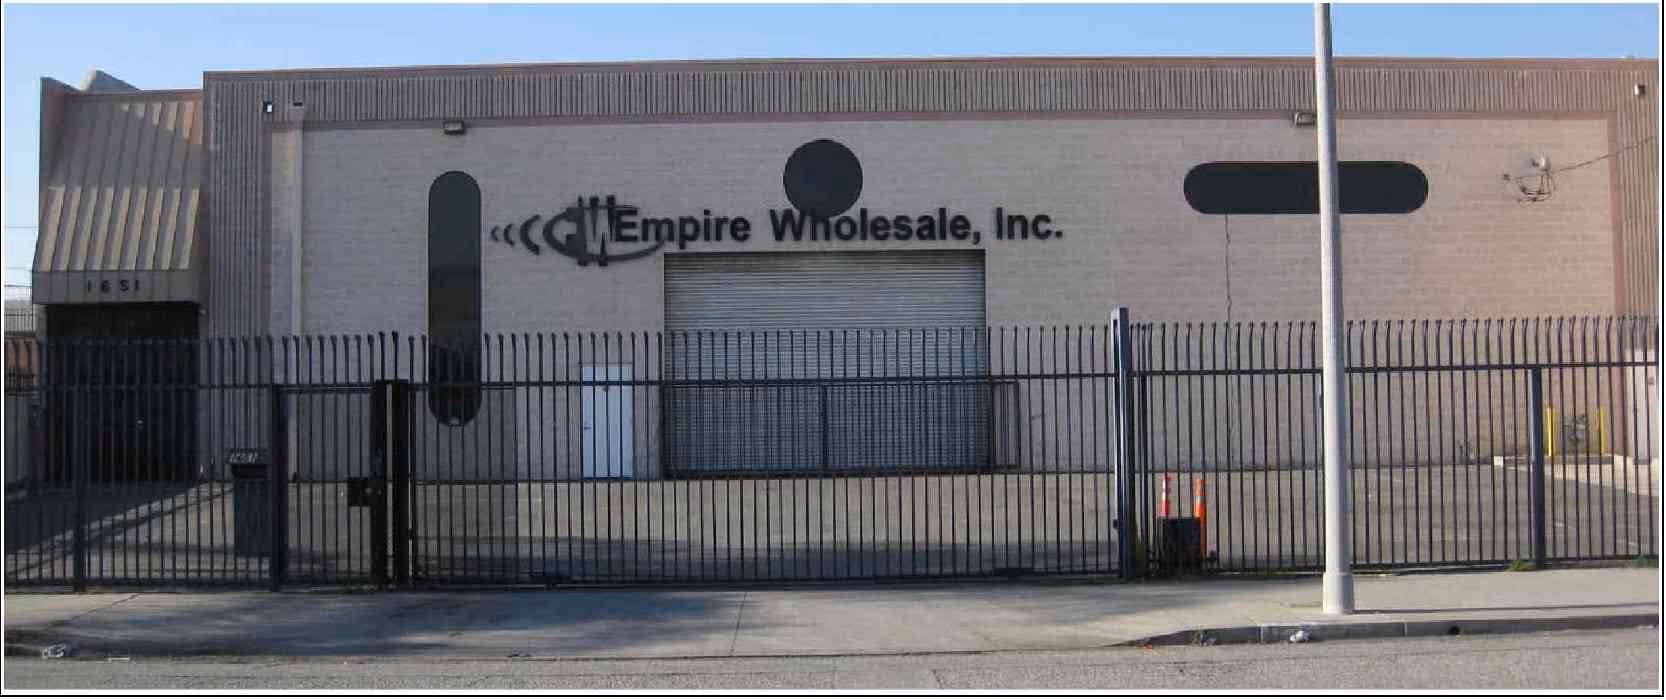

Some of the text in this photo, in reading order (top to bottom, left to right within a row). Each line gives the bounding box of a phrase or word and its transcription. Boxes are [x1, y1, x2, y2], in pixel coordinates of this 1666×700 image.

[615, 206, 1064, 249] Empire Wholesale, Inc.
[87, 279, 140, 294] 1651
